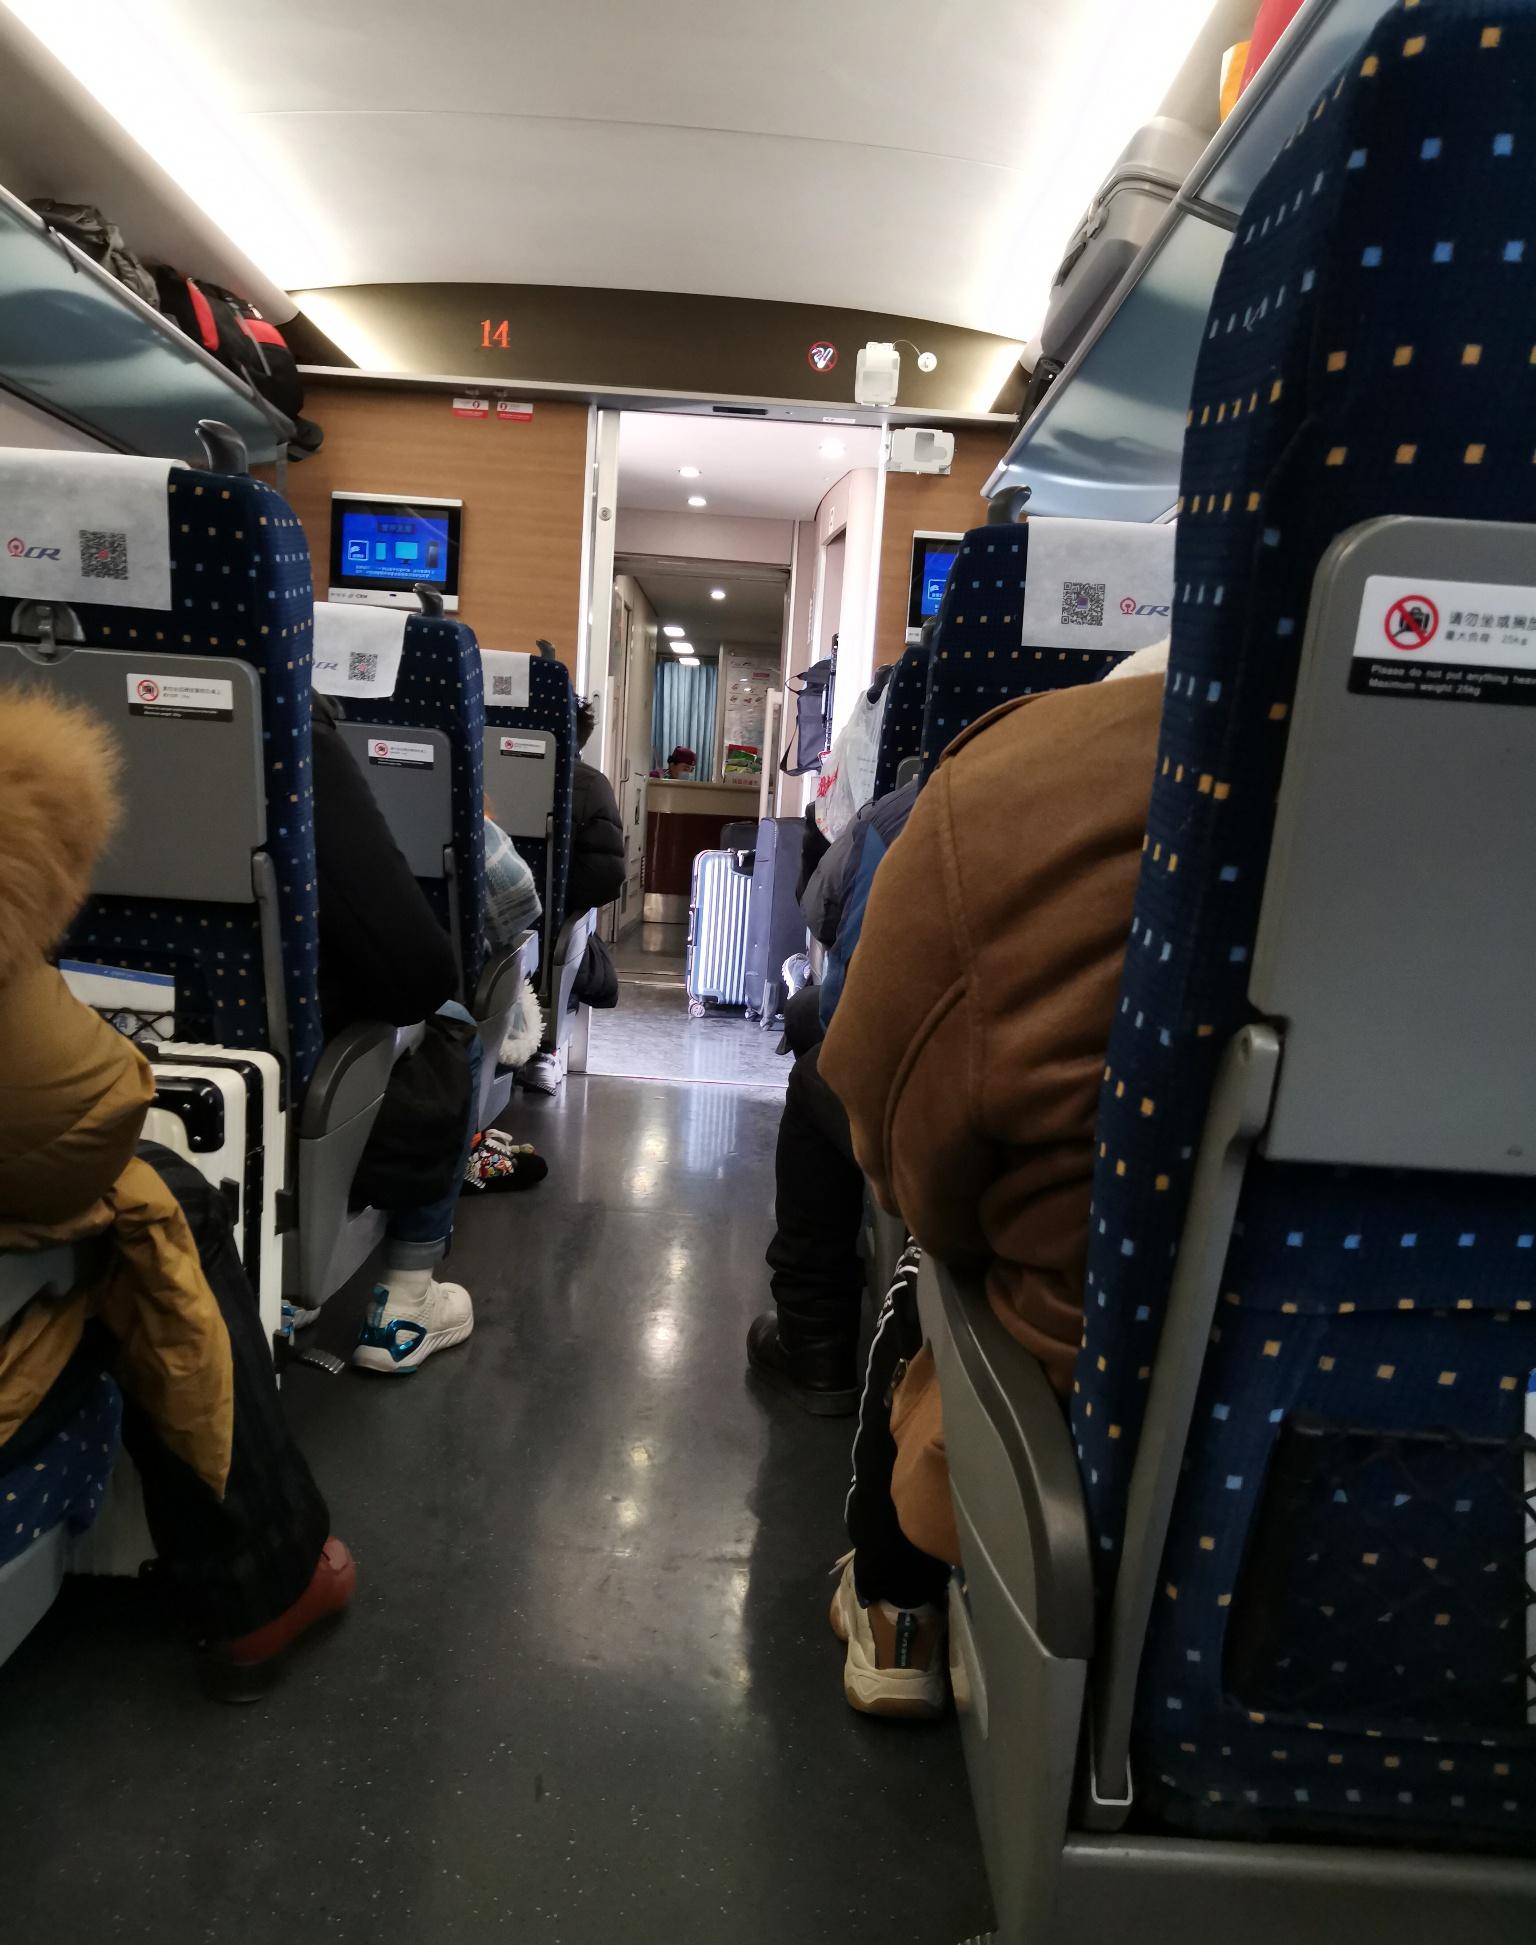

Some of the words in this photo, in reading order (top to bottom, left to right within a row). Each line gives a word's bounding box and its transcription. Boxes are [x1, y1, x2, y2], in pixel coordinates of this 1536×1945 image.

[480, 319, 512, 349] 14
[1371, 664, 1405, 676] Please
[1409, 667, 1422, 678] do
